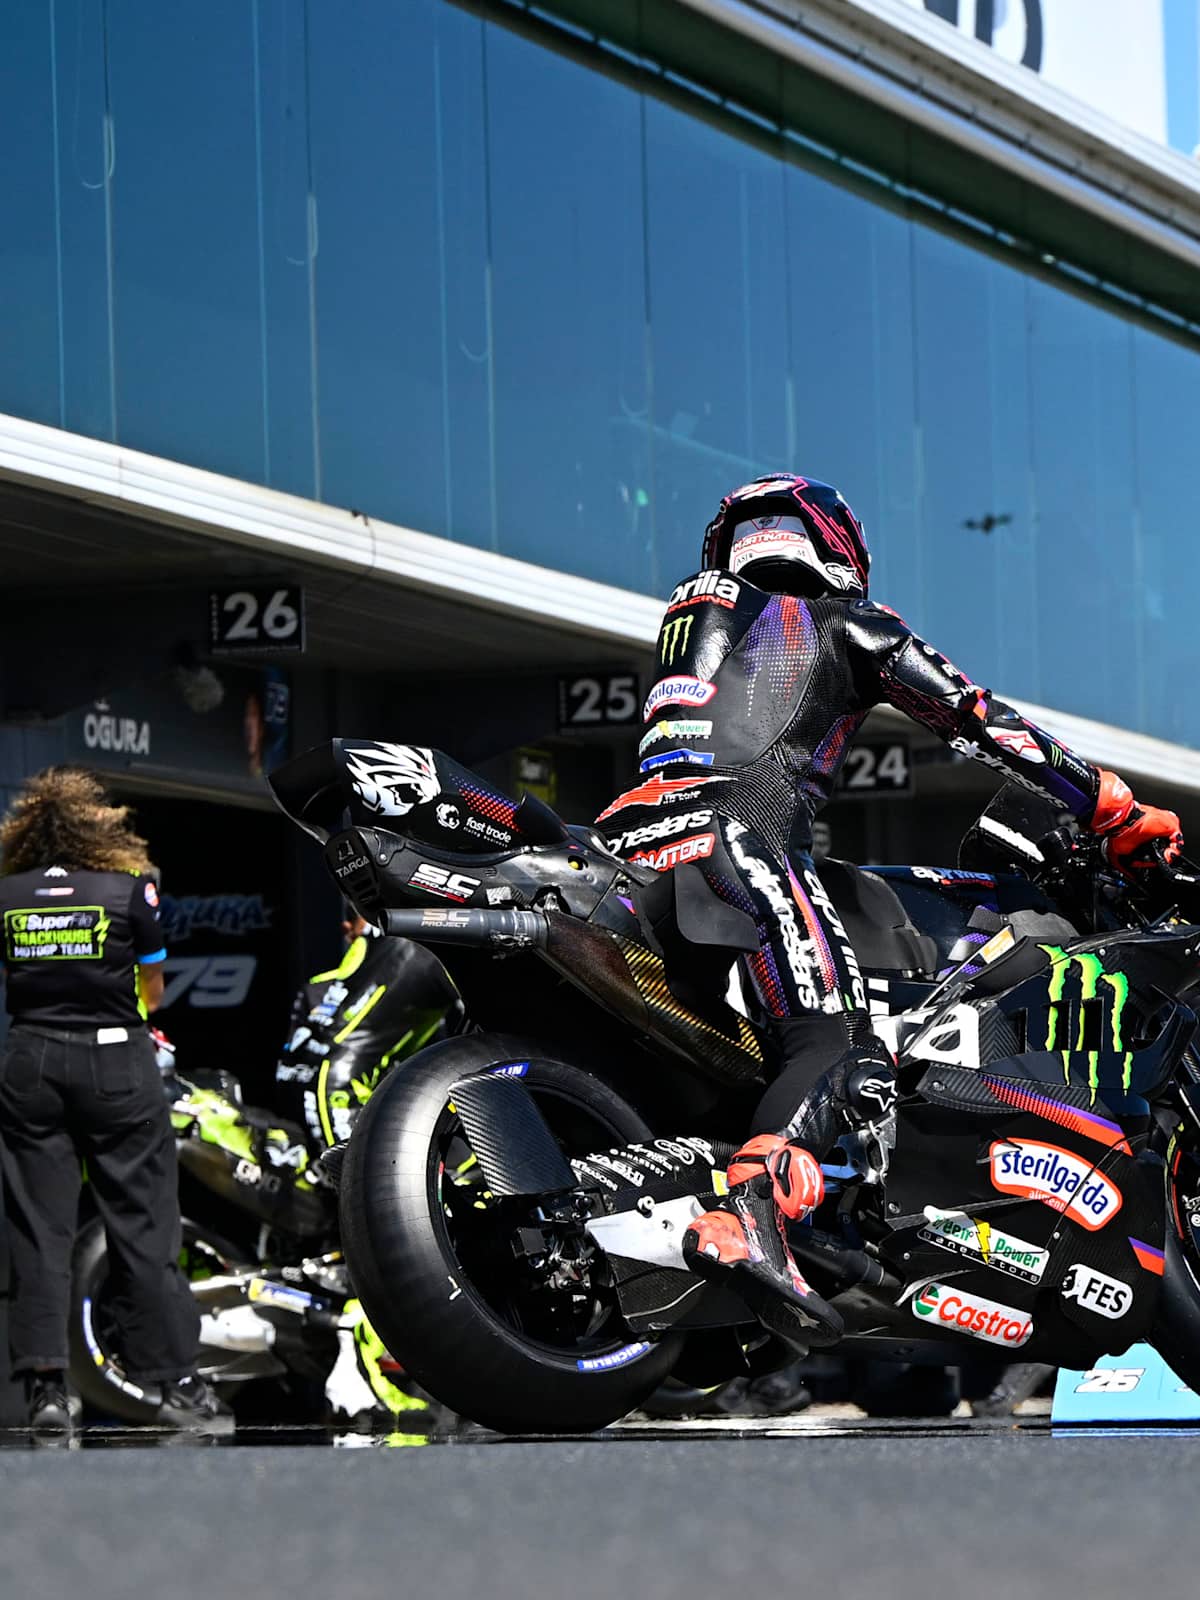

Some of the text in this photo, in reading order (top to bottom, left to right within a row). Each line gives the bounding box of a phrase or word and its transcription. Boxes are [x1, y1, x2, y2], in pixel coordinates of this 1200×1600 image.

[223, 590, 297, 641] 26
[570, 677, 637, 721] 25
[84, 714, 149, 755] OGURA
[848, 745, 908, 788] 24
[948, 736, 1070, 809] alpinestars
[465, 816, 512, 844] fast trade
[336, 855, 370, 879] TARGA
[414, 863, 482, 898] SC
[409, 876, 472, 900] PROJECT
[421, 910, 472, 921] SC
[421, 920, 470, 928] PROJECT
[13, 929, 92, 946] TRACKHOUSE
[62, 943, 93, 956] TEAM
[804, 869, 868, 1015] aprilia
[161, 956, 257, 1009] 79
[994, 1237, 1041, 1269] Power
[1082, 1277, 1128, 1314] FES
[938, 1296, 1031, 1343] Castrol
[582, 1340, 650, 1370] MICHELIN
